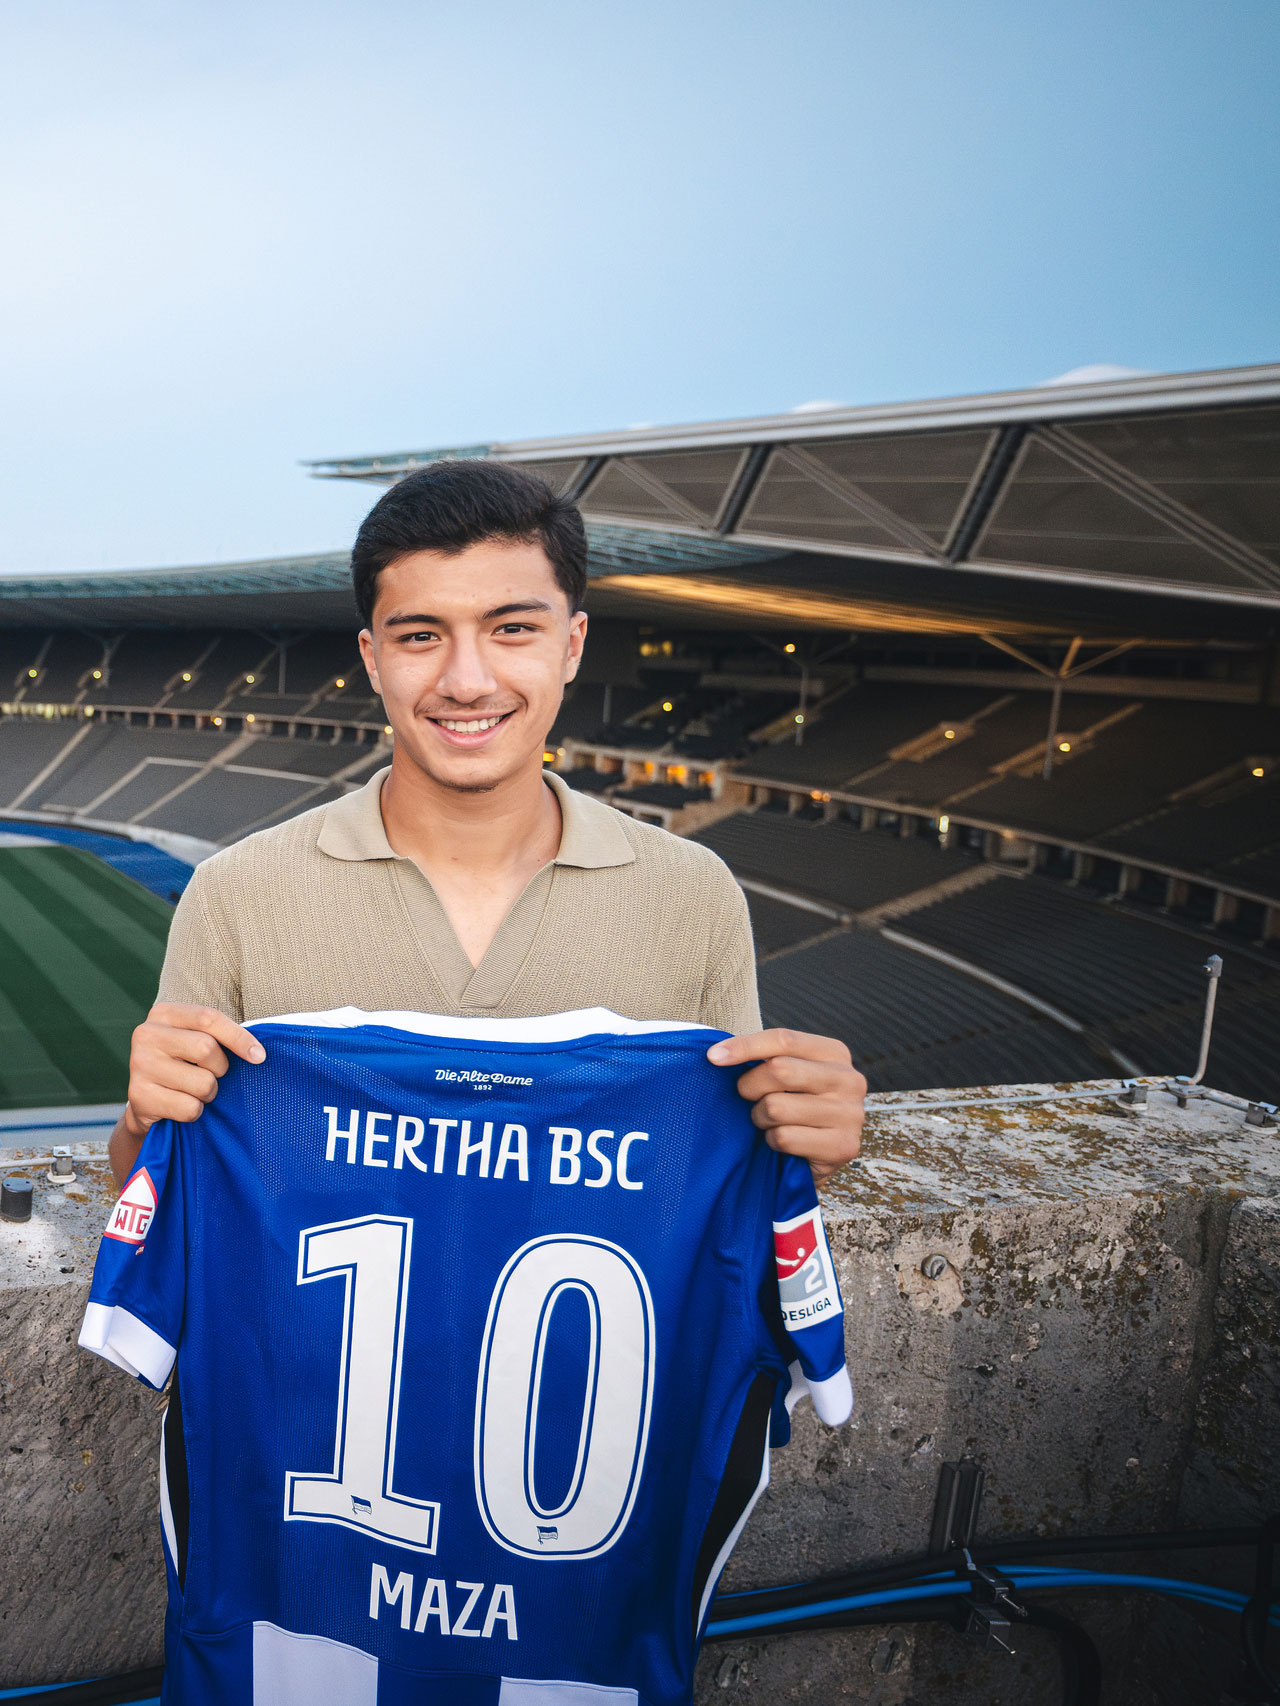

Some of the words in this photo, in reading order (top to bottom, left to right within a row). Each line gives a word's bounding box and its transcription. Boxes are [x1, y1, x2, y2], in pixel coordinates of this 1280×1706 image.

[323, 1105, 529, 1182] HERTHA
[548, 1126, 649, 1191] BSC
[114, 1200, 153, 1235] WTG
[802, 1257, 823, 1294] 2
[284, 1214, 656, 1561] 10
[369, 1562, 518, 1641] MAZA
